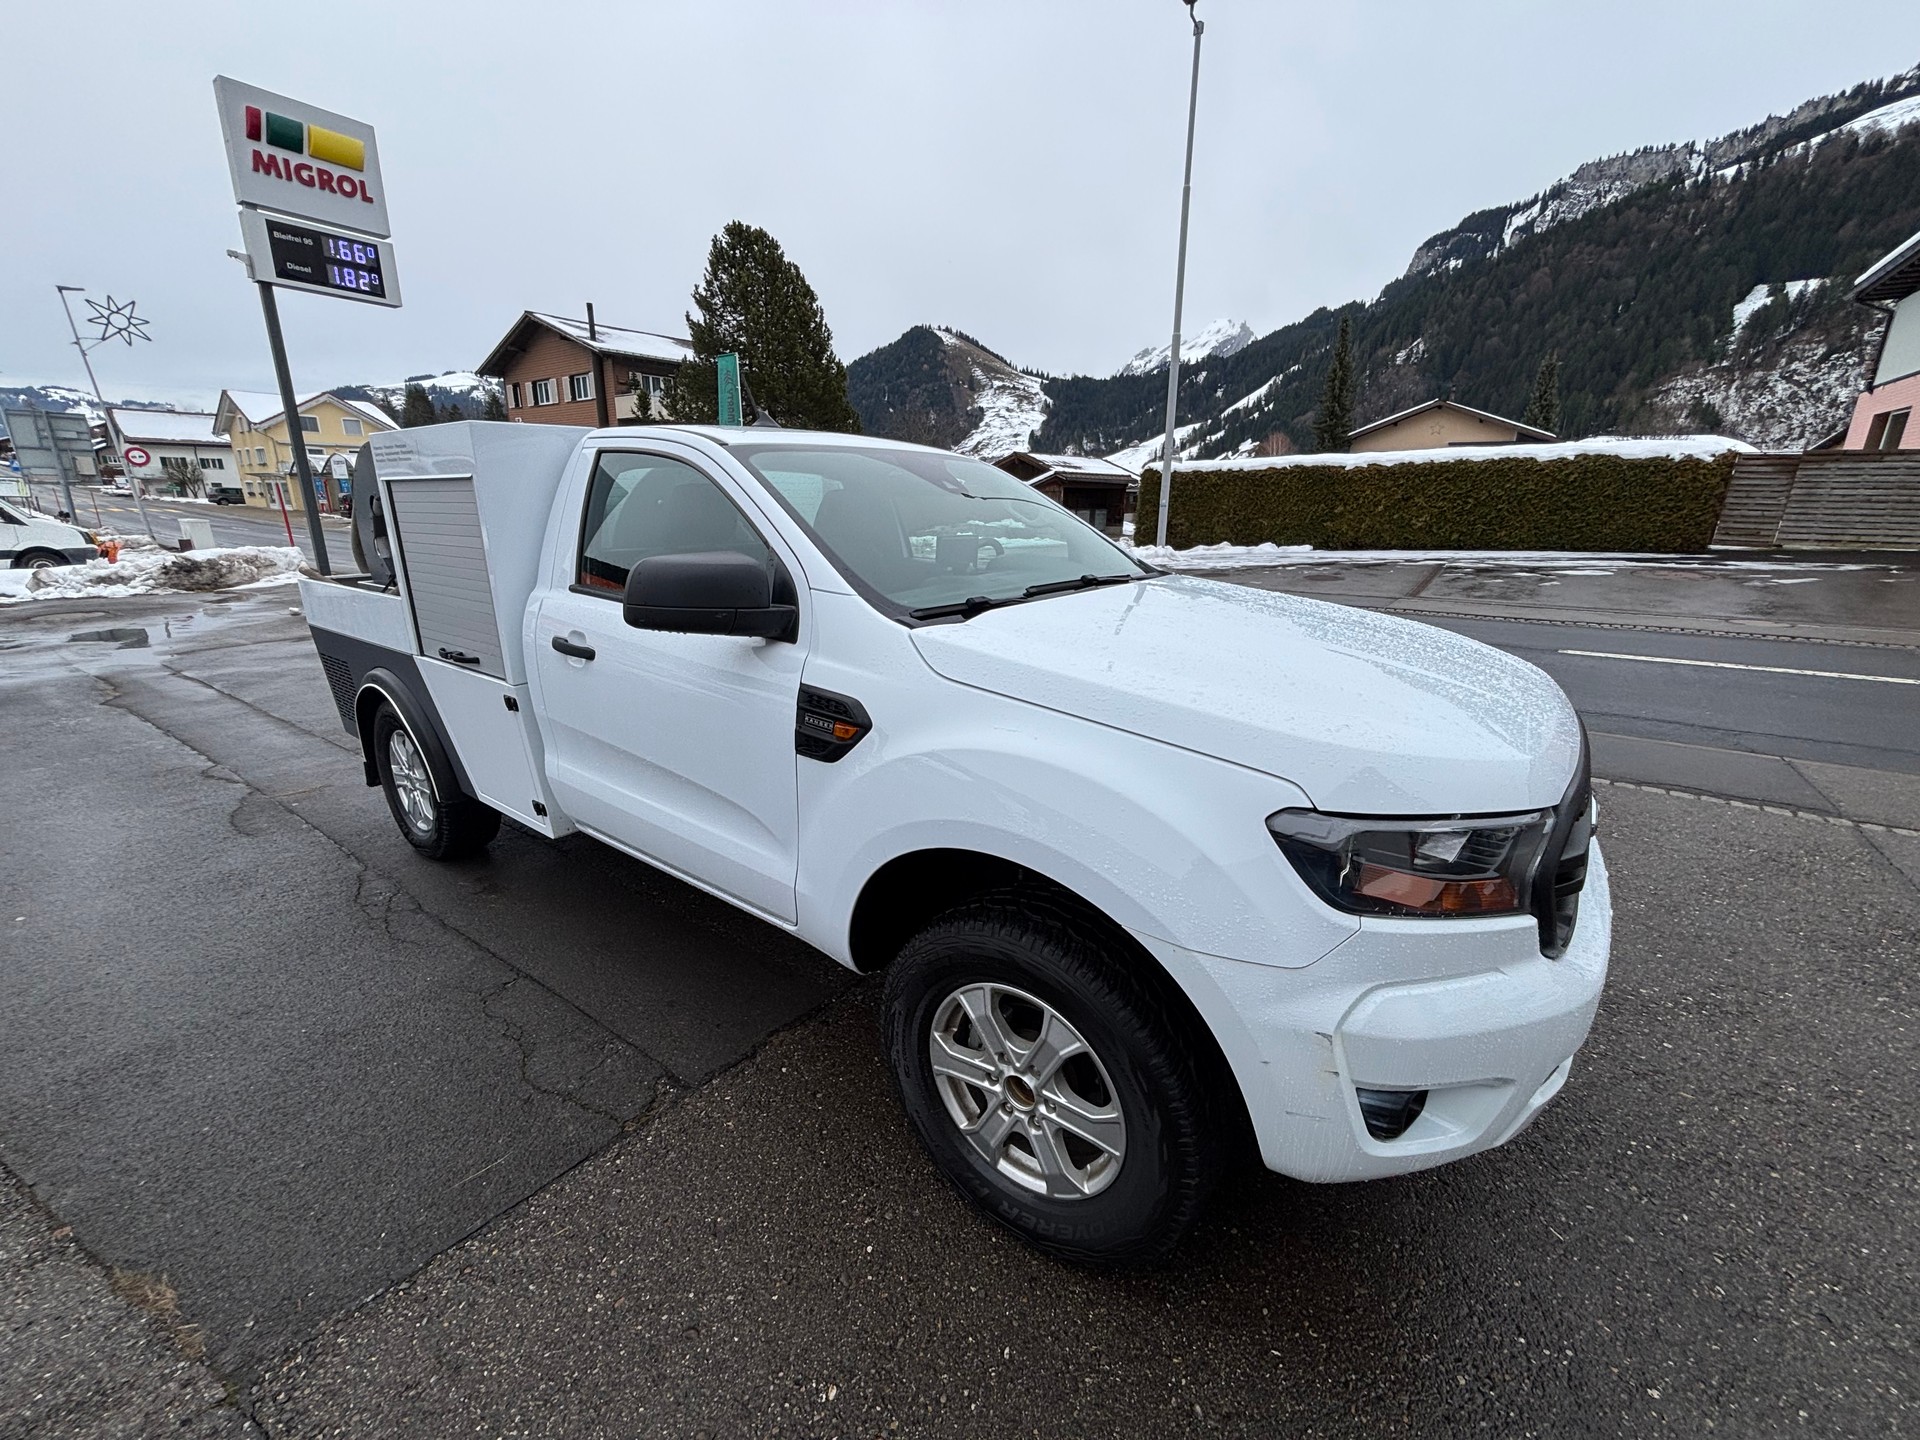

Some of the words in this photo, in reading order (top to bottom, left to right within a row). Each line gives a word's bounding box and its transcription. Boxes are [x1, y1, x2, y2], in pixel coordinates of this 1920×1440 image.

[253, 150, 374, 203] MIGROL
[273, 231, 302, 244] Bleifrei
[303, 238, 314, 246] 95
[286, 262, 312, 274] Diesel
